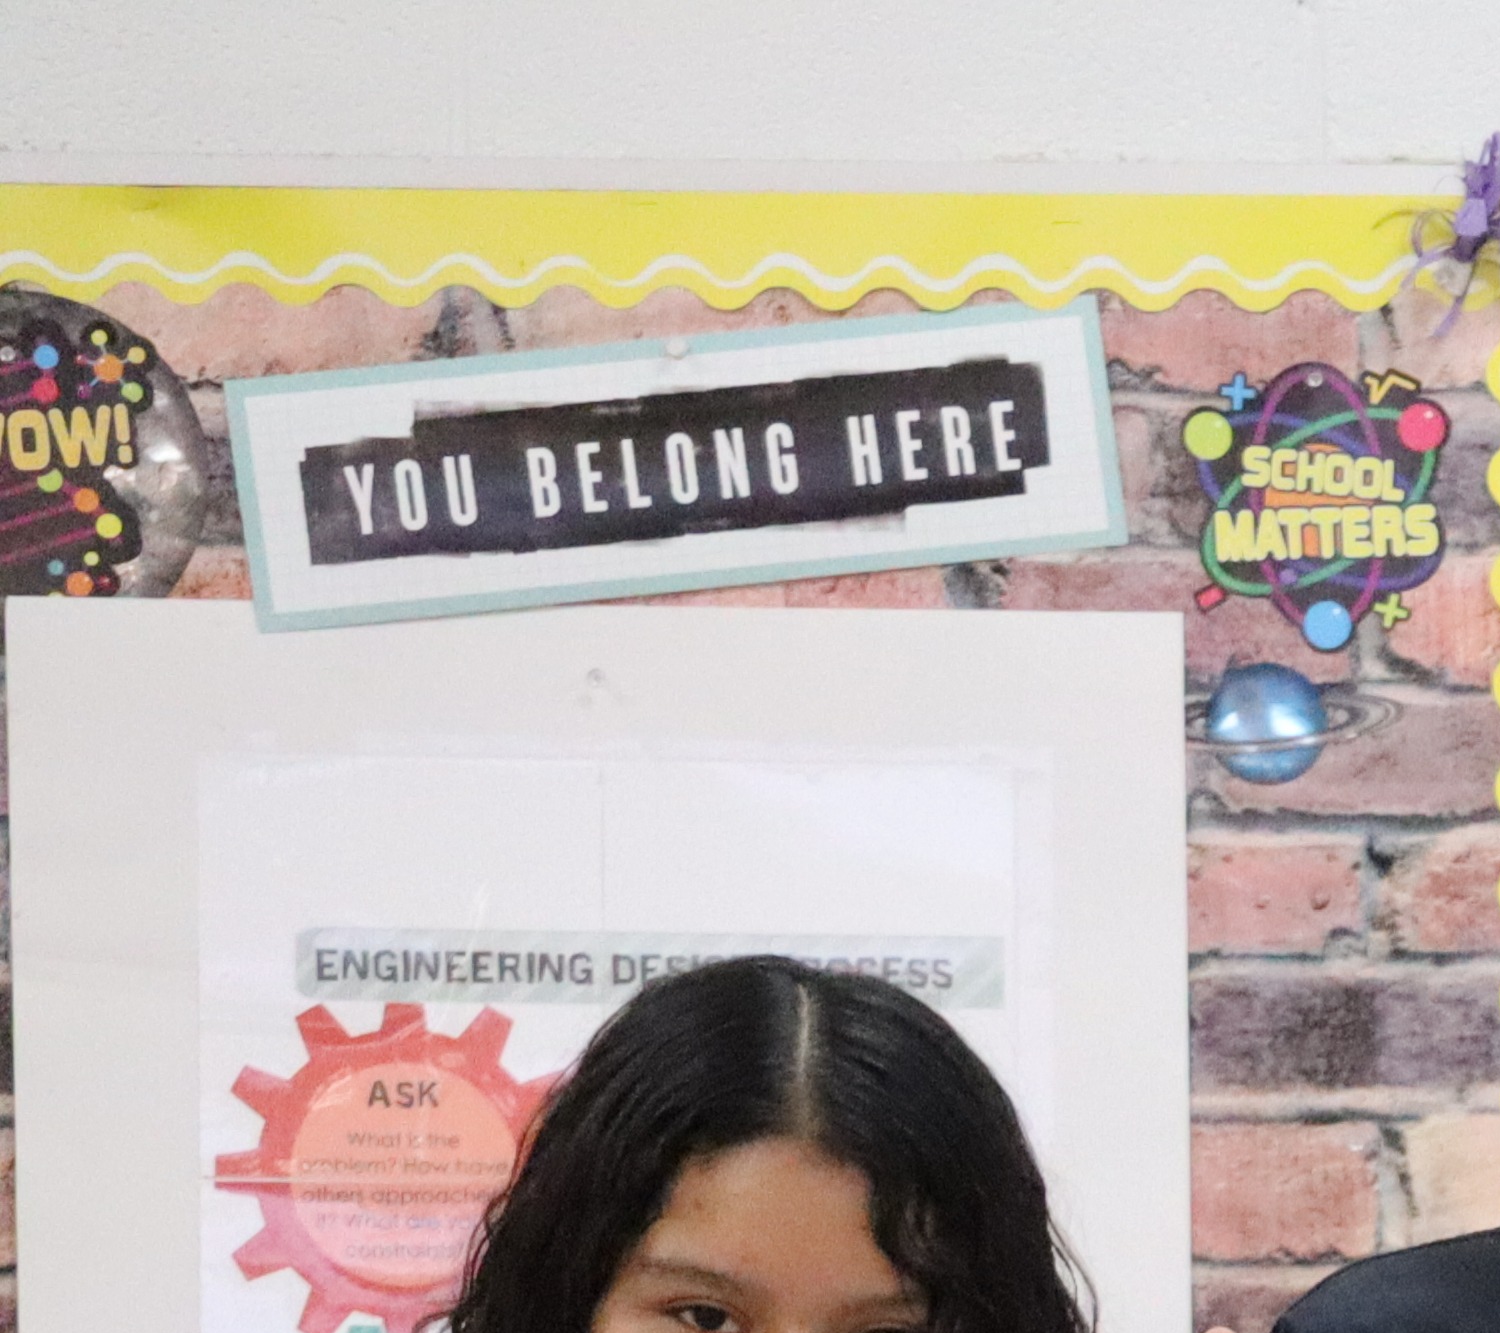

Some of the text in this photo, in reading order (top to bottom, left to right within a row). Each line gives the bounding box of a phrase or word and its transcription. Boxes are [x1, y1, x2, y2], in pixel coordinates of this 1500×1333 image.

[0, 403, 133, 471] OW!
[344, 398, 1024, 536] YOU BELONG HERE
[1240, 444, 1406, 505] SCHOOL
[1212, 502, 1442, 565] MATTERS
[314, 947, 594, 986] ENGINEERING
[367, 1079, 440, 1109] ASK
